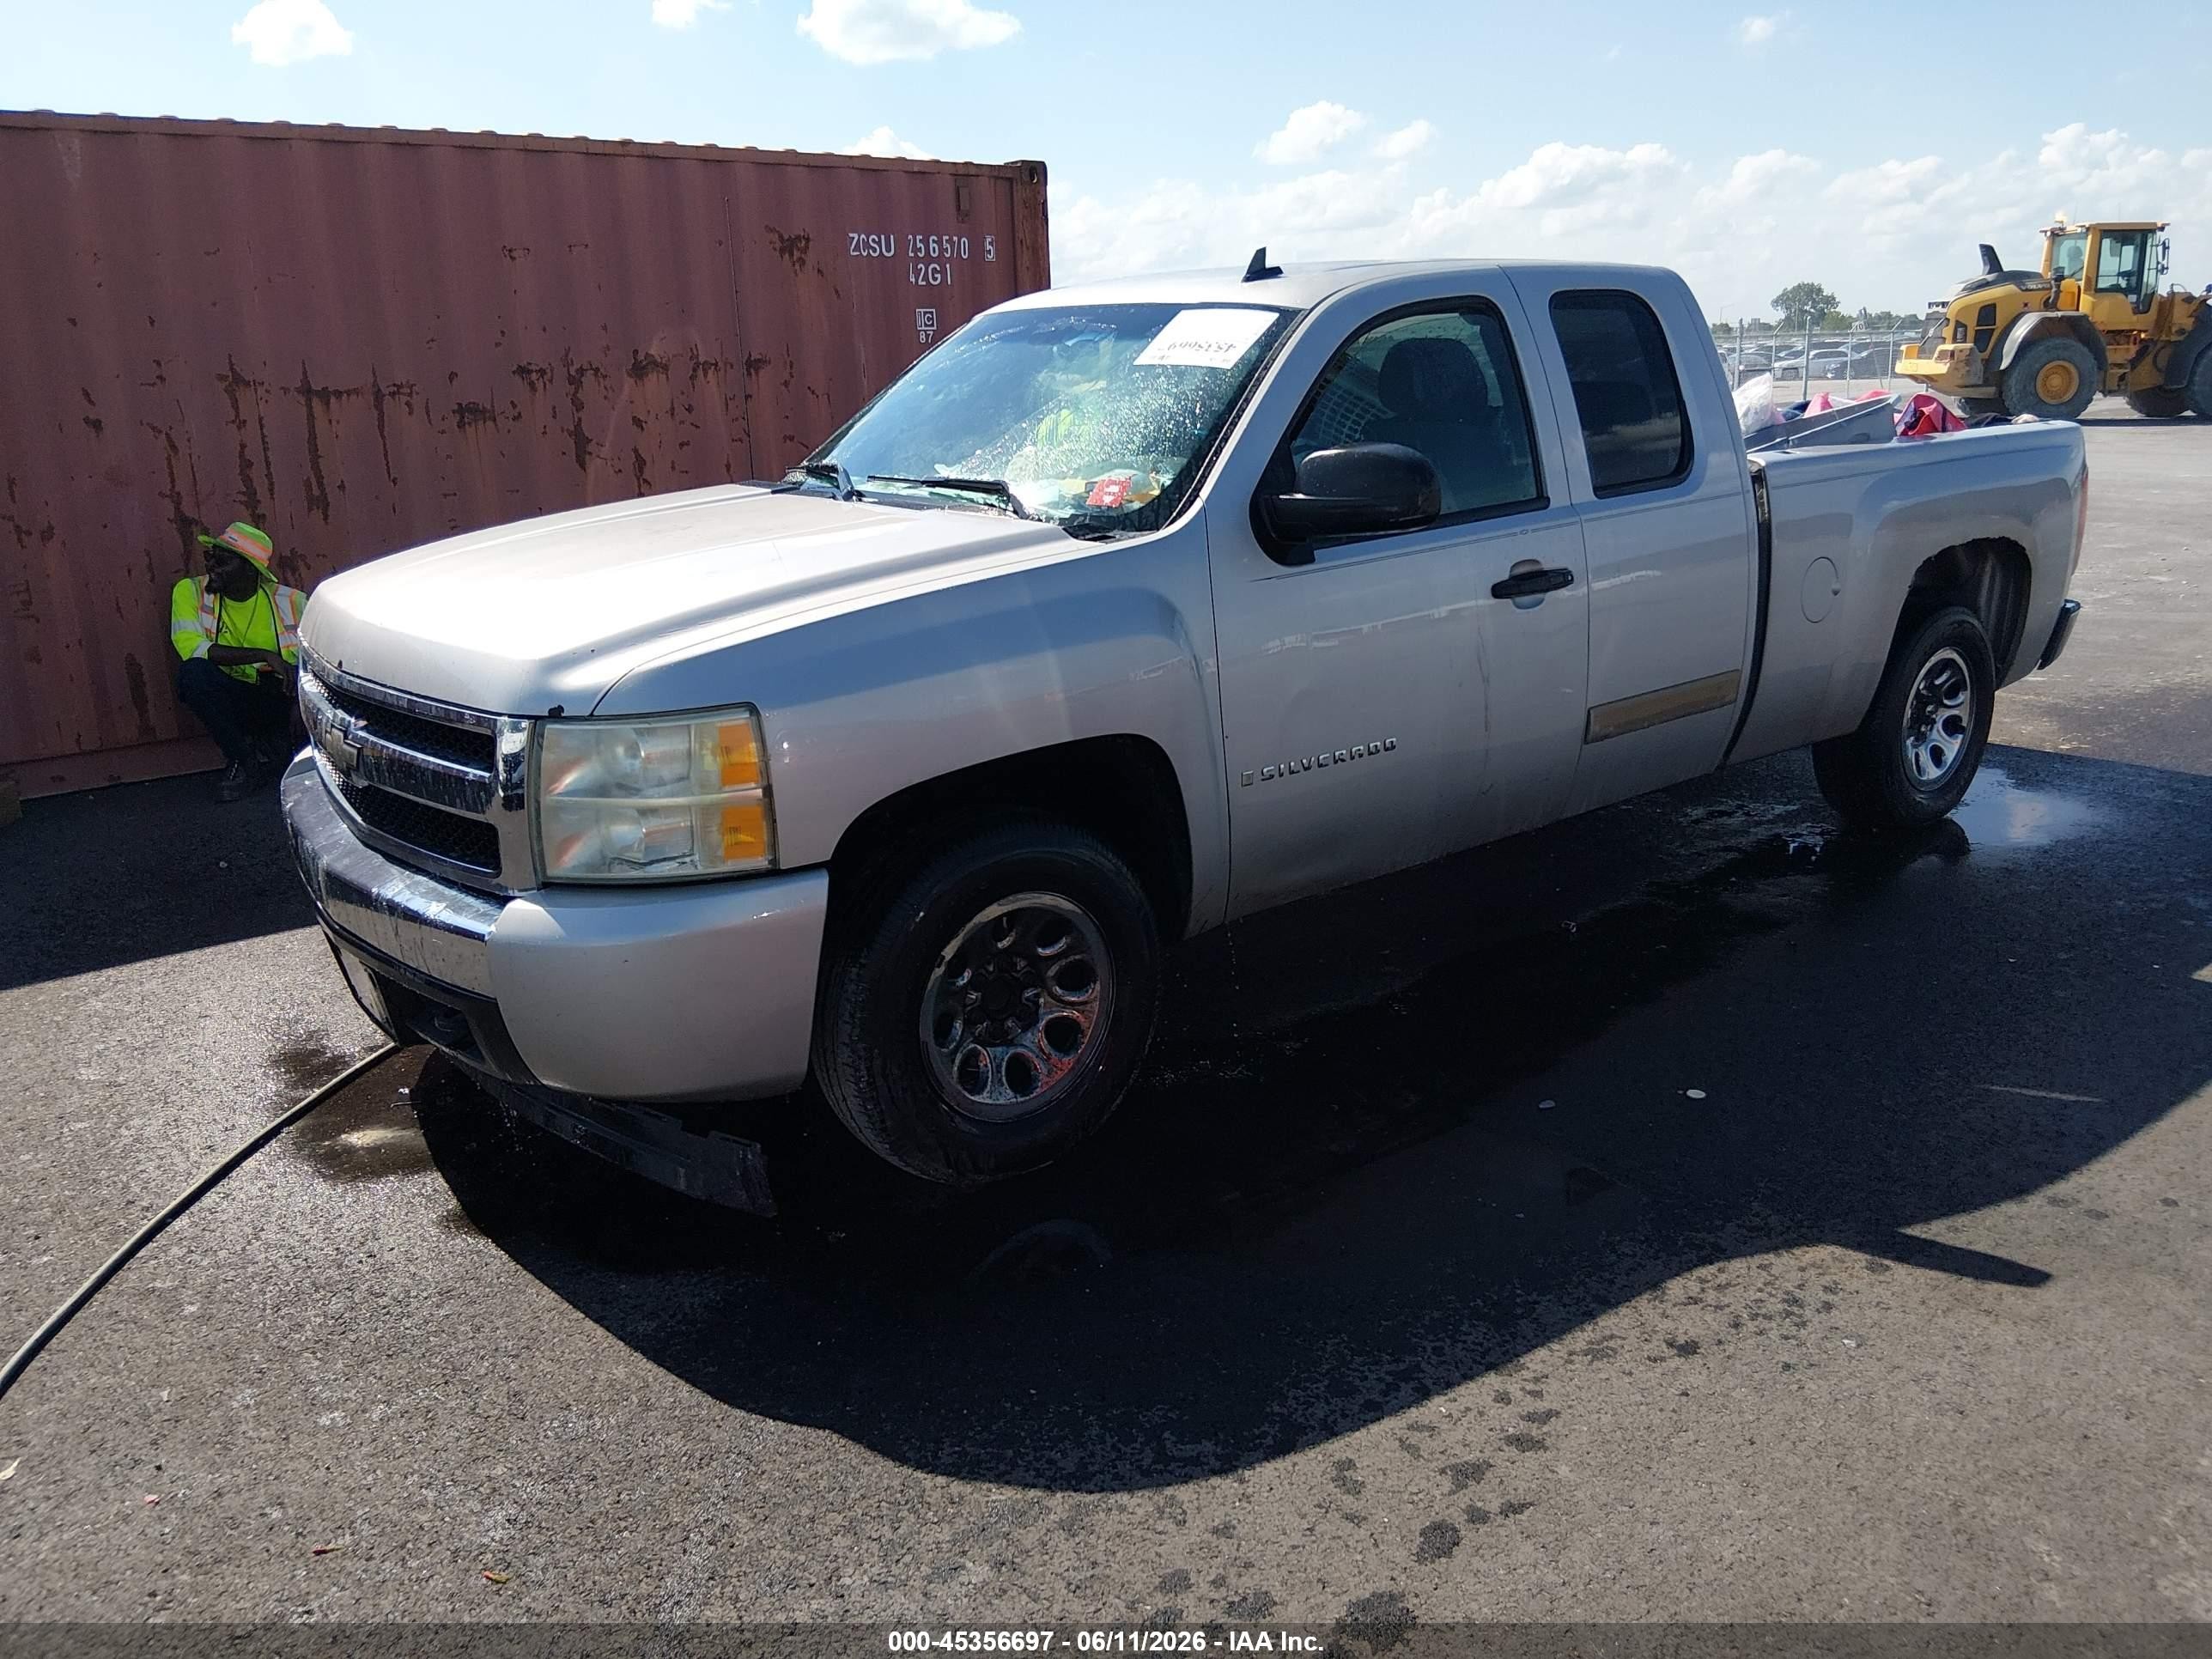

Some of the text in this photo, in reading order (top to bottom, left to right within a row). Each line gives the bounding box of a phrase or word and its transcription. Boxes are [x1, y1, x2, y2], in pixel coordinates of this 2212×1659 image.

[848, 233, 994, 259] ZCSU 256570 5
[910, 262, 951, 285] 42G1
[920, 331, 933, 343] 87
[1261, 738, 1397, 782] SILVERADO
